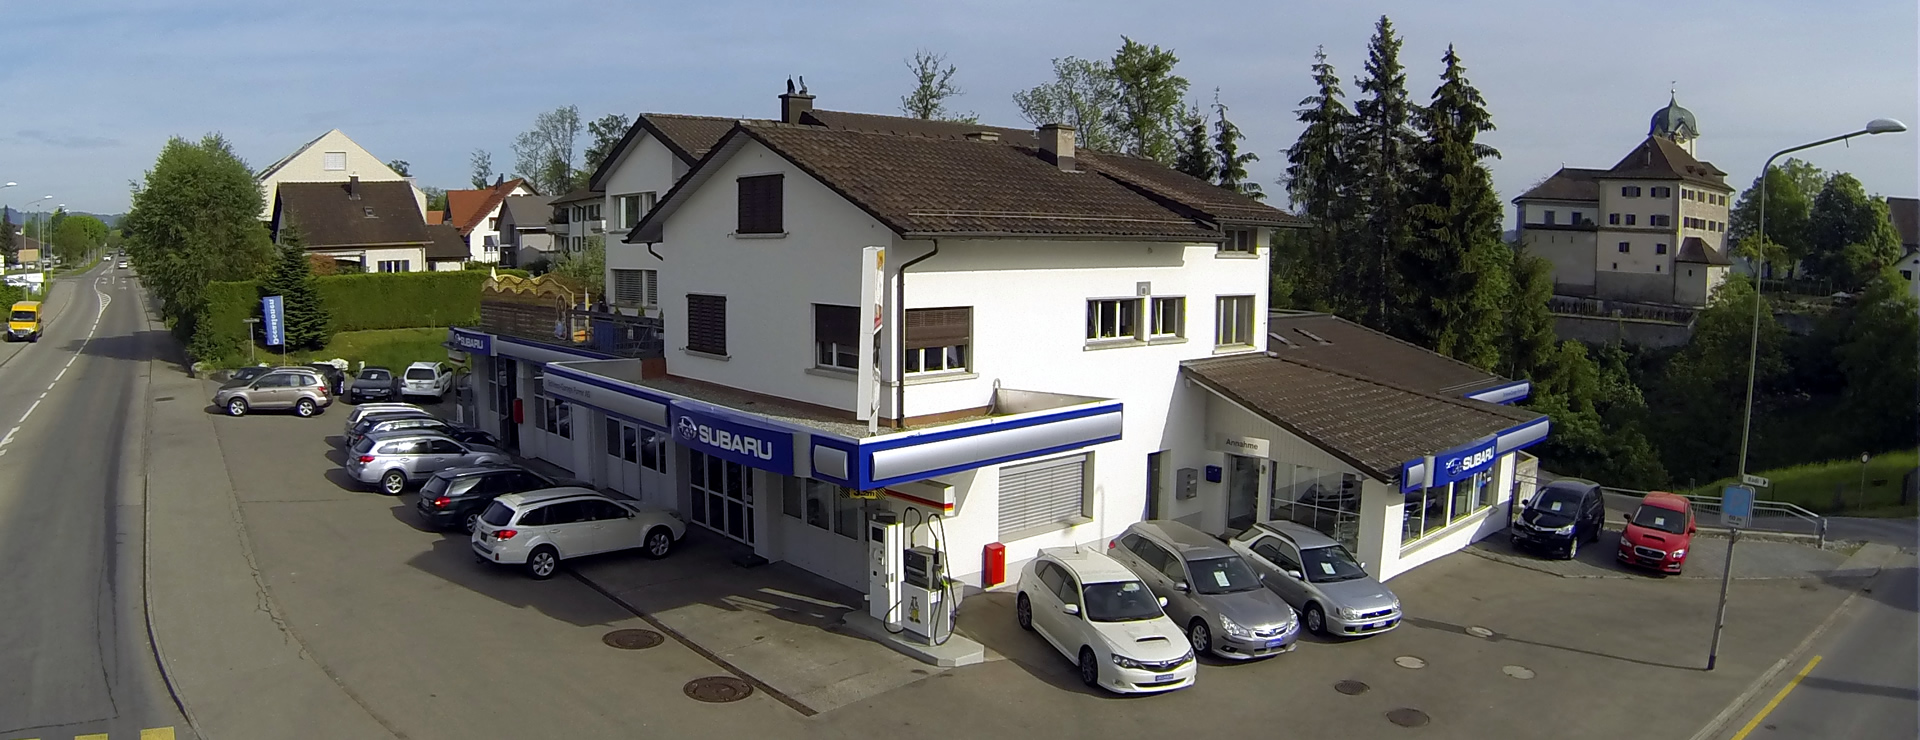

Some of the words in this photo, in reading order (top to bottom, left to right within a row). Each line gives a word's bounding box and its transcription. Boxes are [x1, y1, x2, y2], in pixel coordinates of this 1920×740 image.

[461, 336, 484, 350] SUBARU
[698, 424, 773, 460] SUBARU
[1225, 438, 1259, 450] Annahme
[1462, 445, 1495, 471] SUBARU
